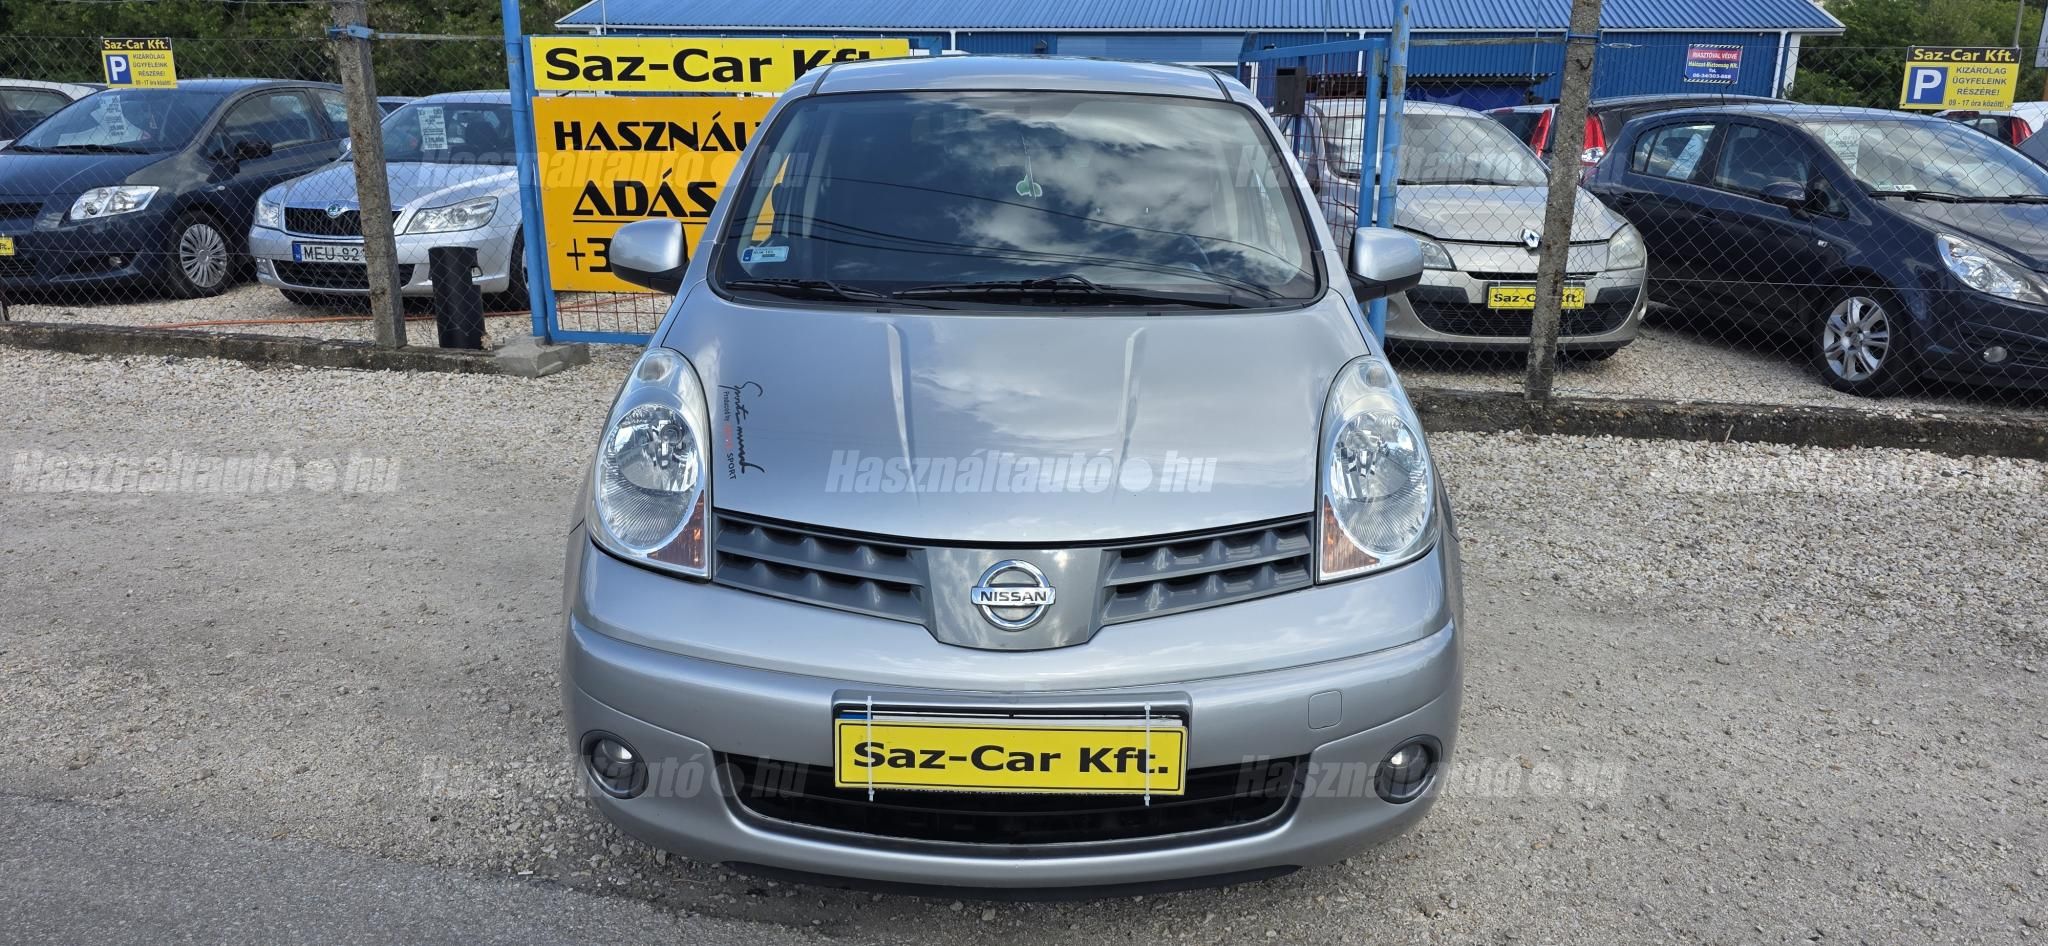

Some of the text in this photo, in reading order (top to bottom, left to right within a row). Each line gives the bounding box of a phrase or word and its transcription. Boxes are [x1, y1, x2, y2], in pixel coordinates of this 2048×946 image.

[104, 39, 168, 50] Saz-Car Kft.
[545, 47, 773, 83] Saz-Car
[1913, 48, 2015, 62] Saz-Car Kft.
[110, 55, 126, 81] P
[1913, 69, 1942, 100] P
[1952, 77, 2008, 85] ÜGYFELEINK
[1956, 87, 2000, 96] RÉSZÉRE!
[554, 111, 762, 152] HASZNÁL
[1494, 293, 1537, 303] Saz-C
[727, 452, 737, 480] SPORT
[980, 591, 1047, 602] NISSAN
[854, 741, 1169, 774] Saz-Car Kft.
